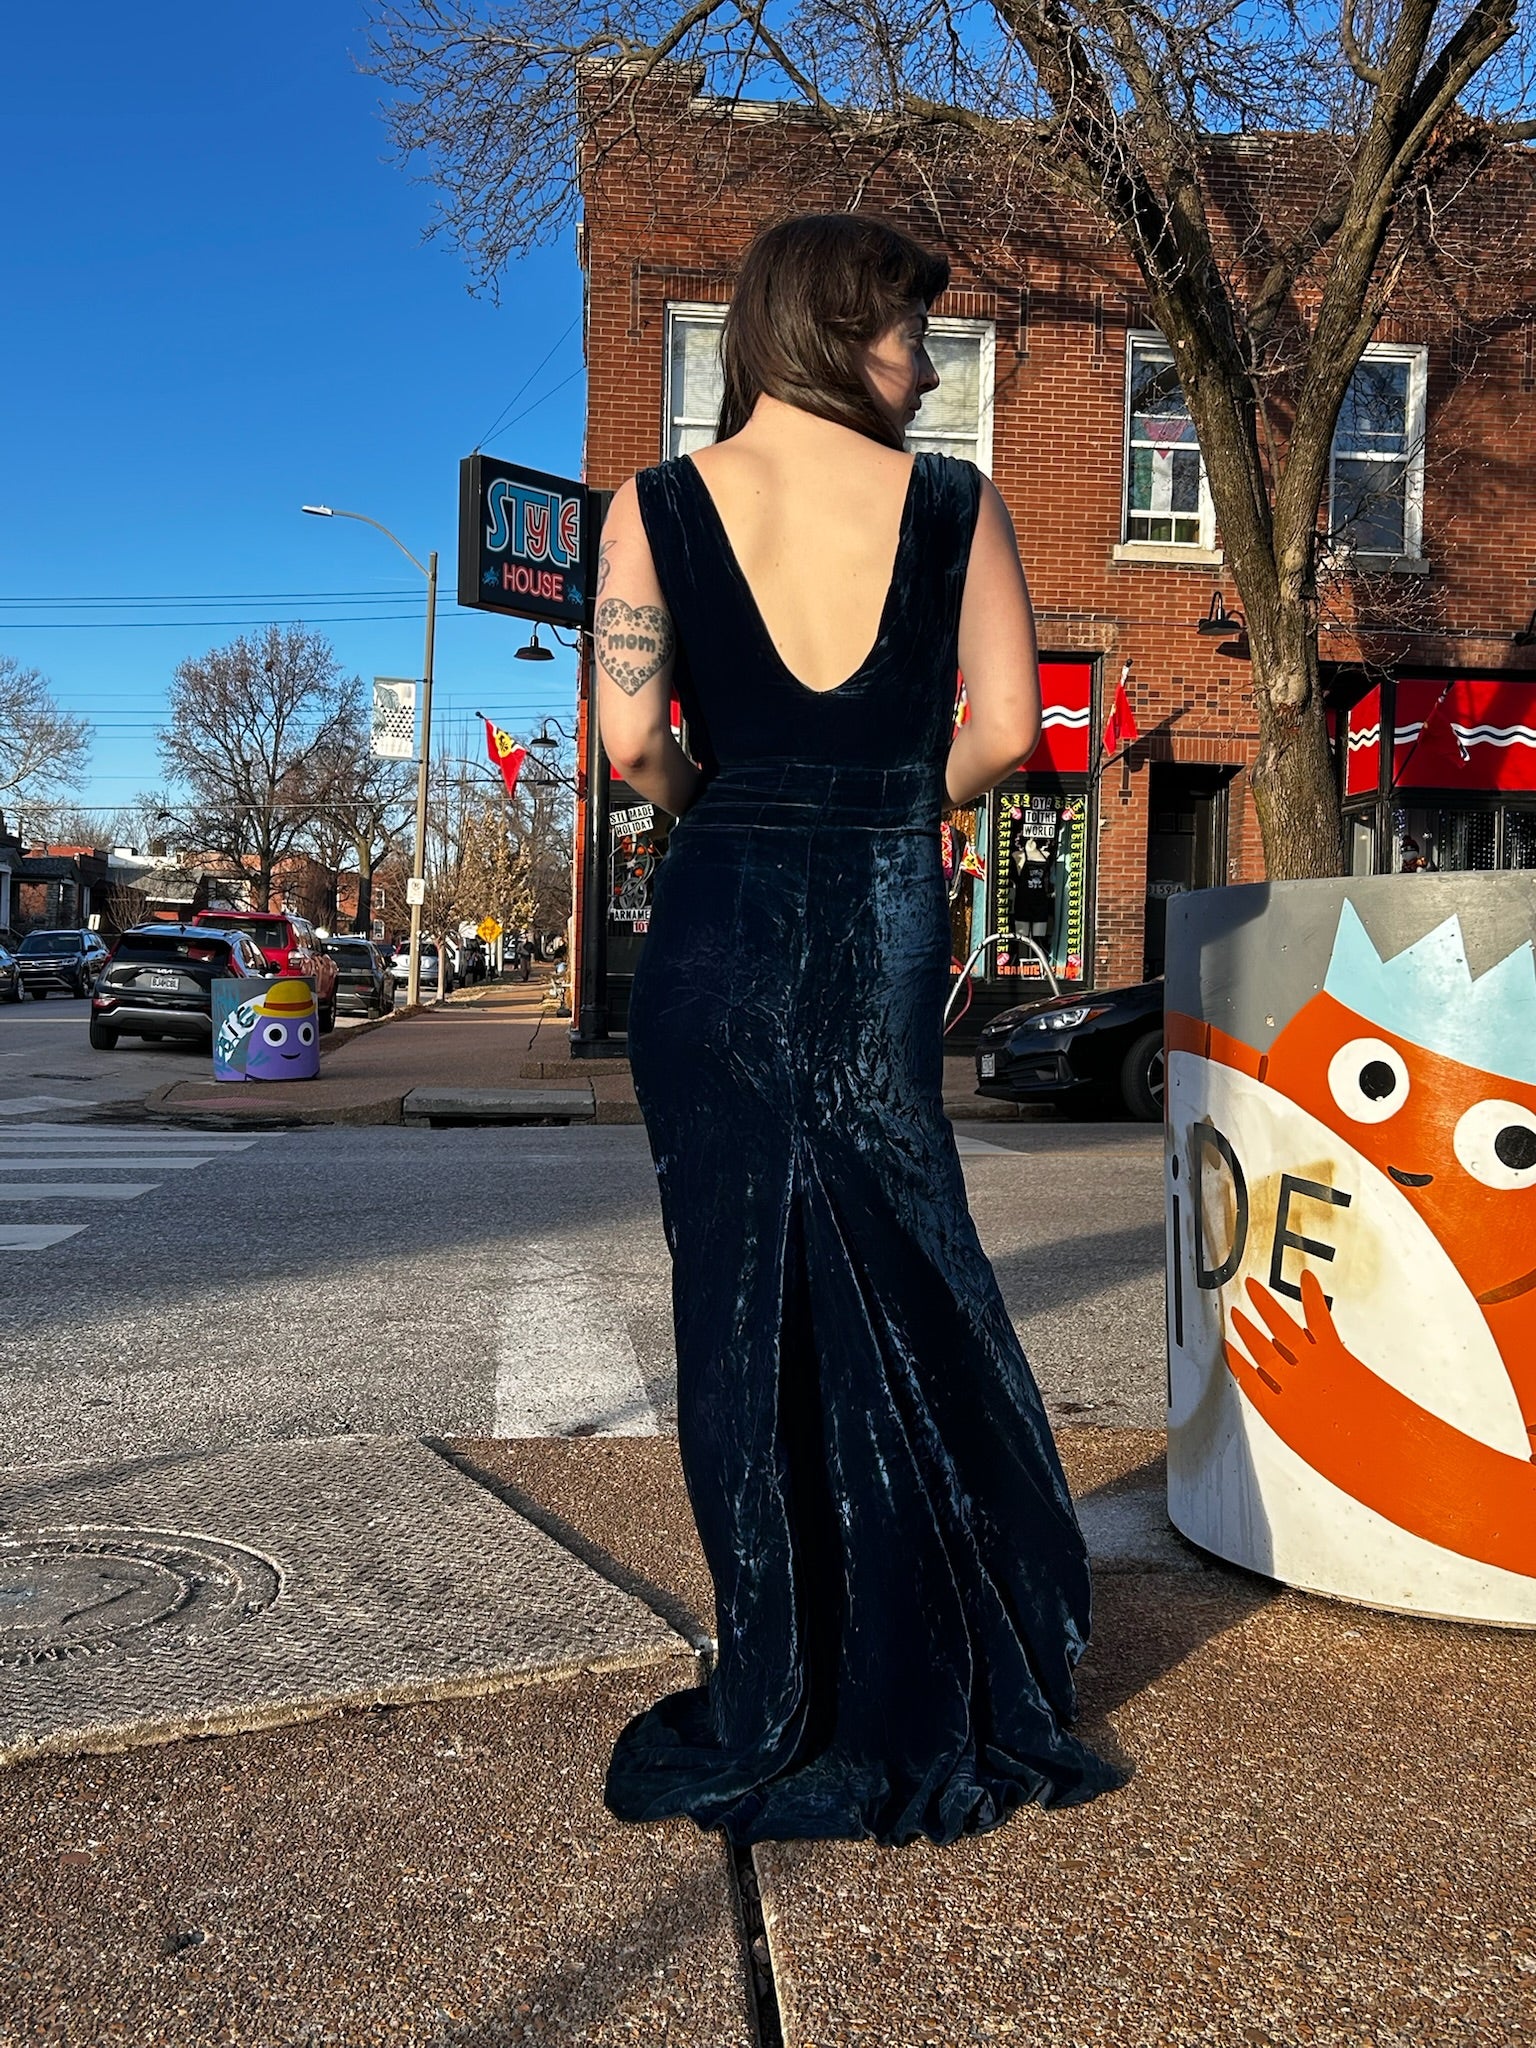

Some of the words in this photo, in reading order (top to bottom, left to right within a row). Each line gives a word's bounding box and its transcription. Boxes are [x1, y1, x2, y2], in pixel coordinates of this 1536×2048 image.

[486, 478, 580, 568] STYLE
[502, 562, 564, 602] HOUSE
[608, 634, 656, 653] mom
[629, 805, 653, 819] MADE
[1026, 811, 1038, 822] TO
[1039, 811, 1056, 823] THE
[616, 819, 652, 836] HOLIDAY
[1024, 825, 1055, 837] WORLD
